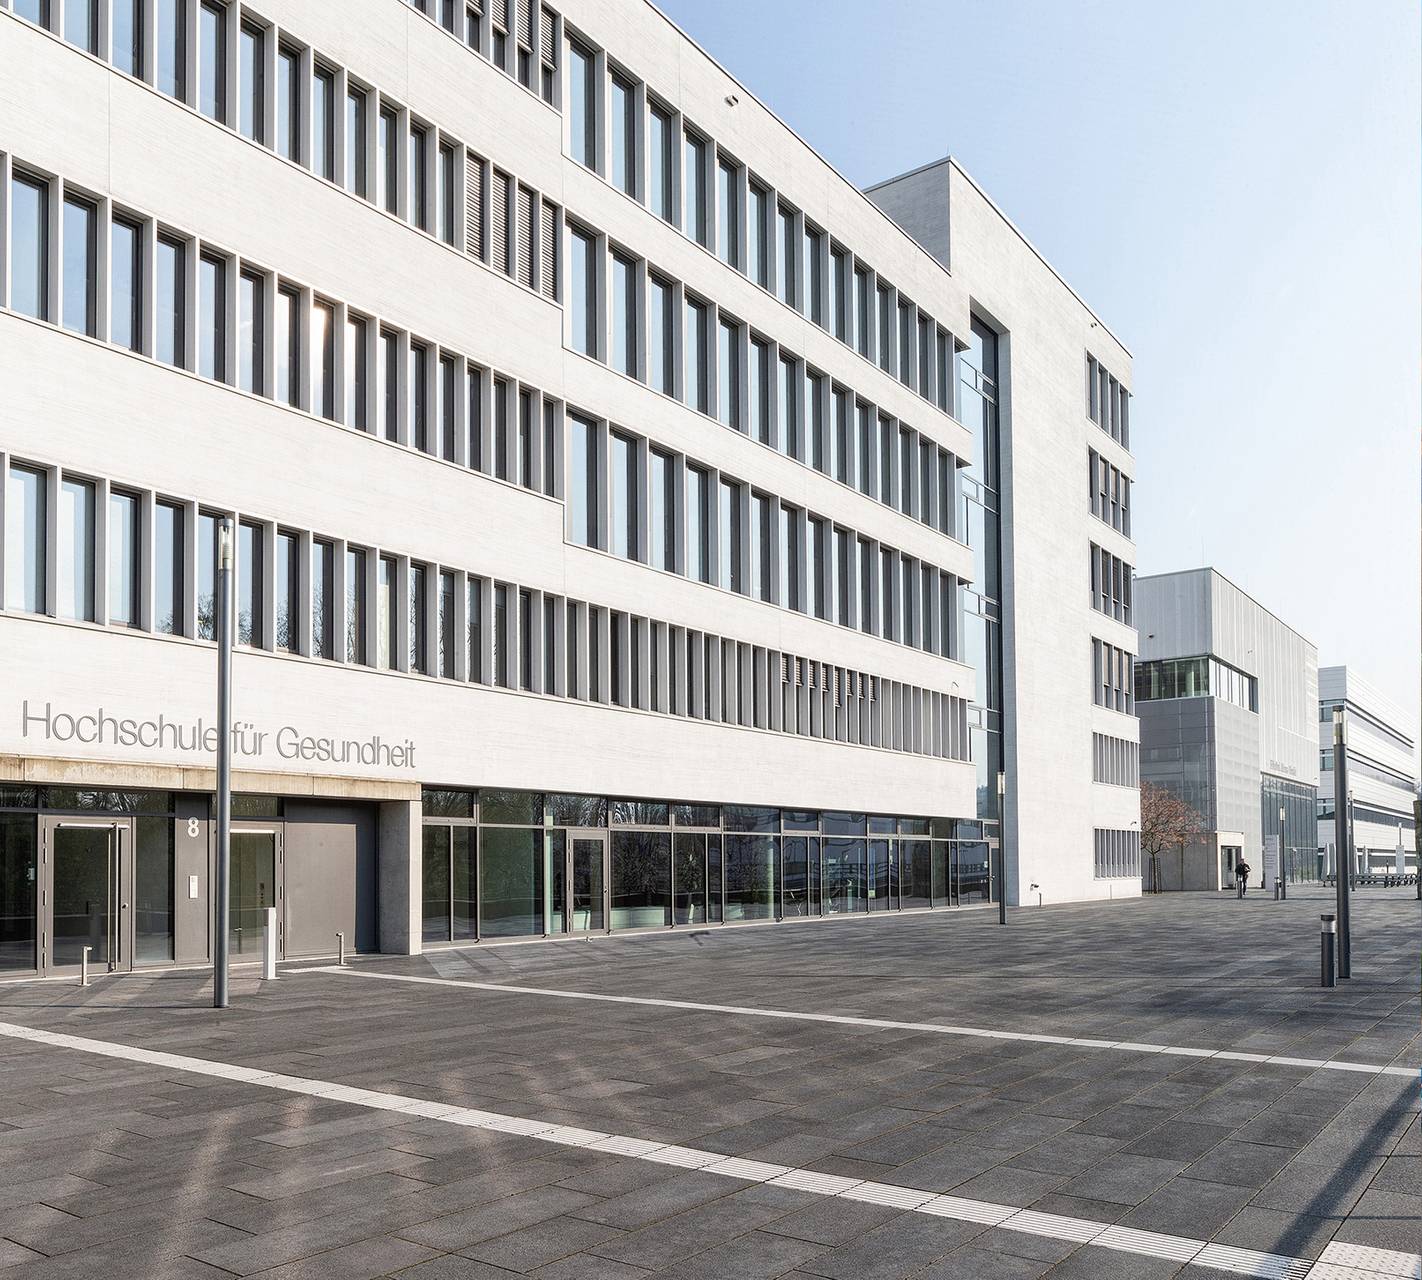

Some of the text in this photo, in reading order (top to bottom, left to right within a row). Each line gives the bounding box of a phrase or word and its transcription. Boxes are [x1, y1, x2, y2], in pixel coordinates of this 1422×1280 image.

[23, 700, 416, 768] Hochschule für Gesundheit
[188, 817, 199, 837] 8
